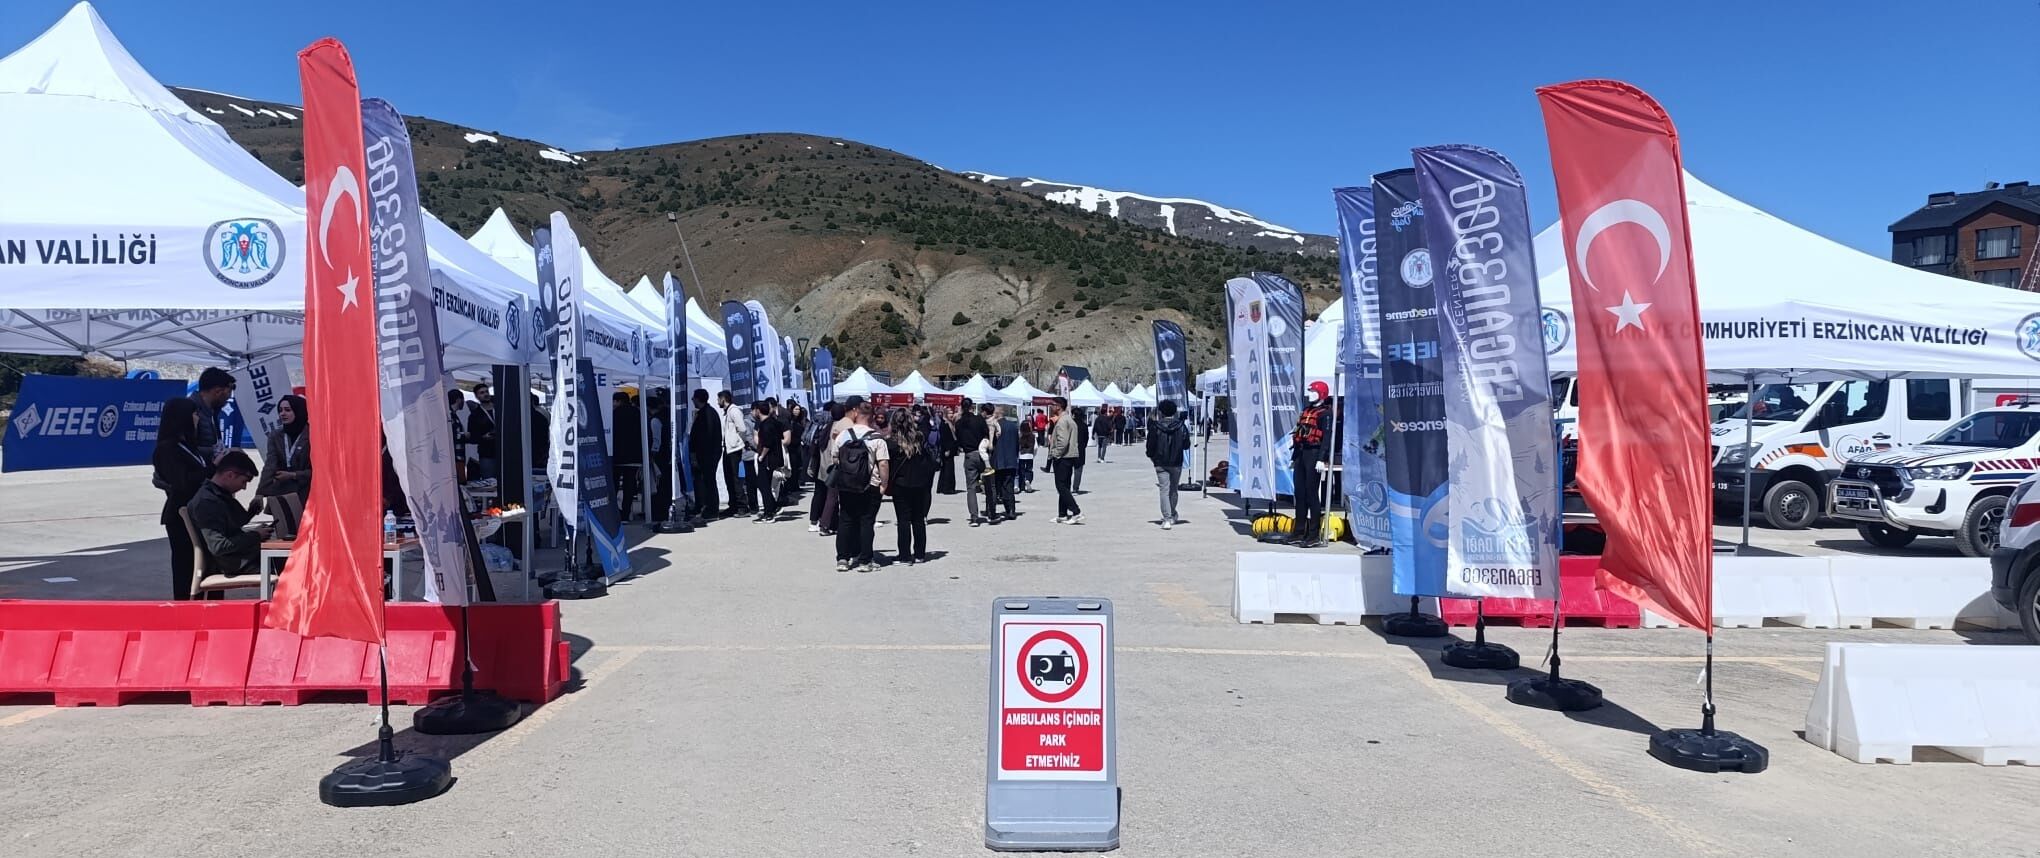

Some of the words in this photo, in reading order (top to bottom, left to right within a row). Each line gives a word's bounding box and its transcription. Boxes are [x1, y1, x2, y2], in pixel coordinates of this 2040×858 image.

[35, 233, 156, 264] VALİLİĞİ
[1813, 319, 1905, 343] ERZİNCAN
[1909, 325, 1988, 346] VALİLİĞİ
[249, 365, 273, 403] IEEE
[39, 407, 98, 436] IEEE
[1847, 446, 1872, 454] AFAD
[1005, 712, 1060, 726] AMBULANS
[1062, 710, 1101, 729] İÇİNDİR
[1039, 734, 1067, 747] PARK
[1025, 753, 1081, 768] ETMEYİNİZ
